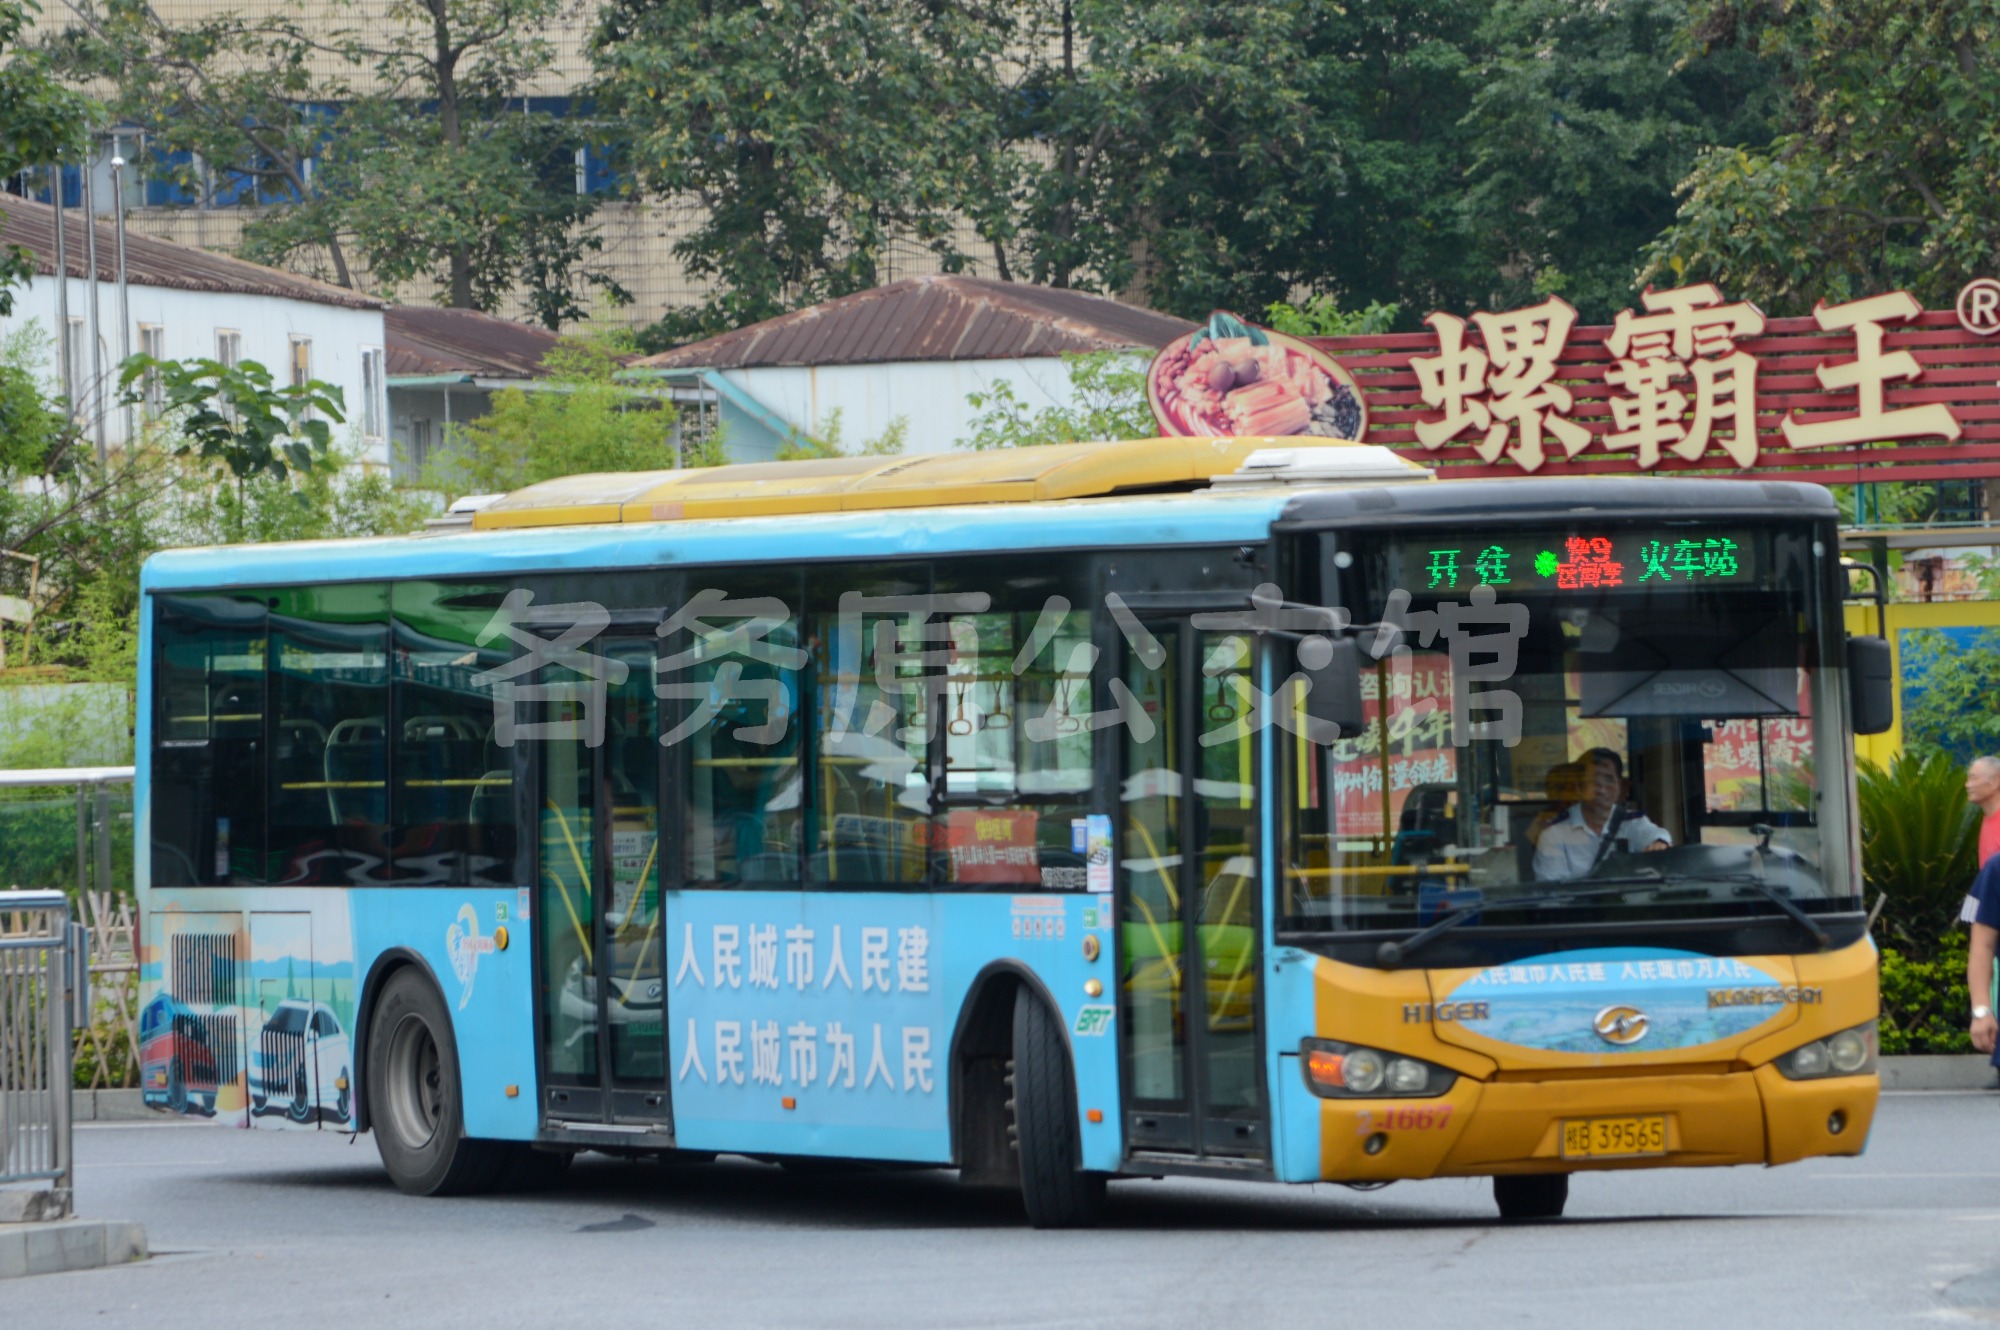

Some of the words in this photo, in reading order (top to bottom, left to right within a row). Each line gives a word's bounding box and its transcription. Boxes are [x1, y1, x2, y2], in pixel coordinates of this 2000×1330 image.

[1409, 283, 1962, 472] 螺霸王
[1426, 546, 1511, 588] 开往
[1639, 538, 1738, 581] 火车站
[675, 922, 929, 992] 人民城市人民建
[1076, 1008, 1112, 1032] BRT
[1403, 1001, 1490, 1024] HIGER
[678, 1018, 934, 1094] 人民城市为人民
